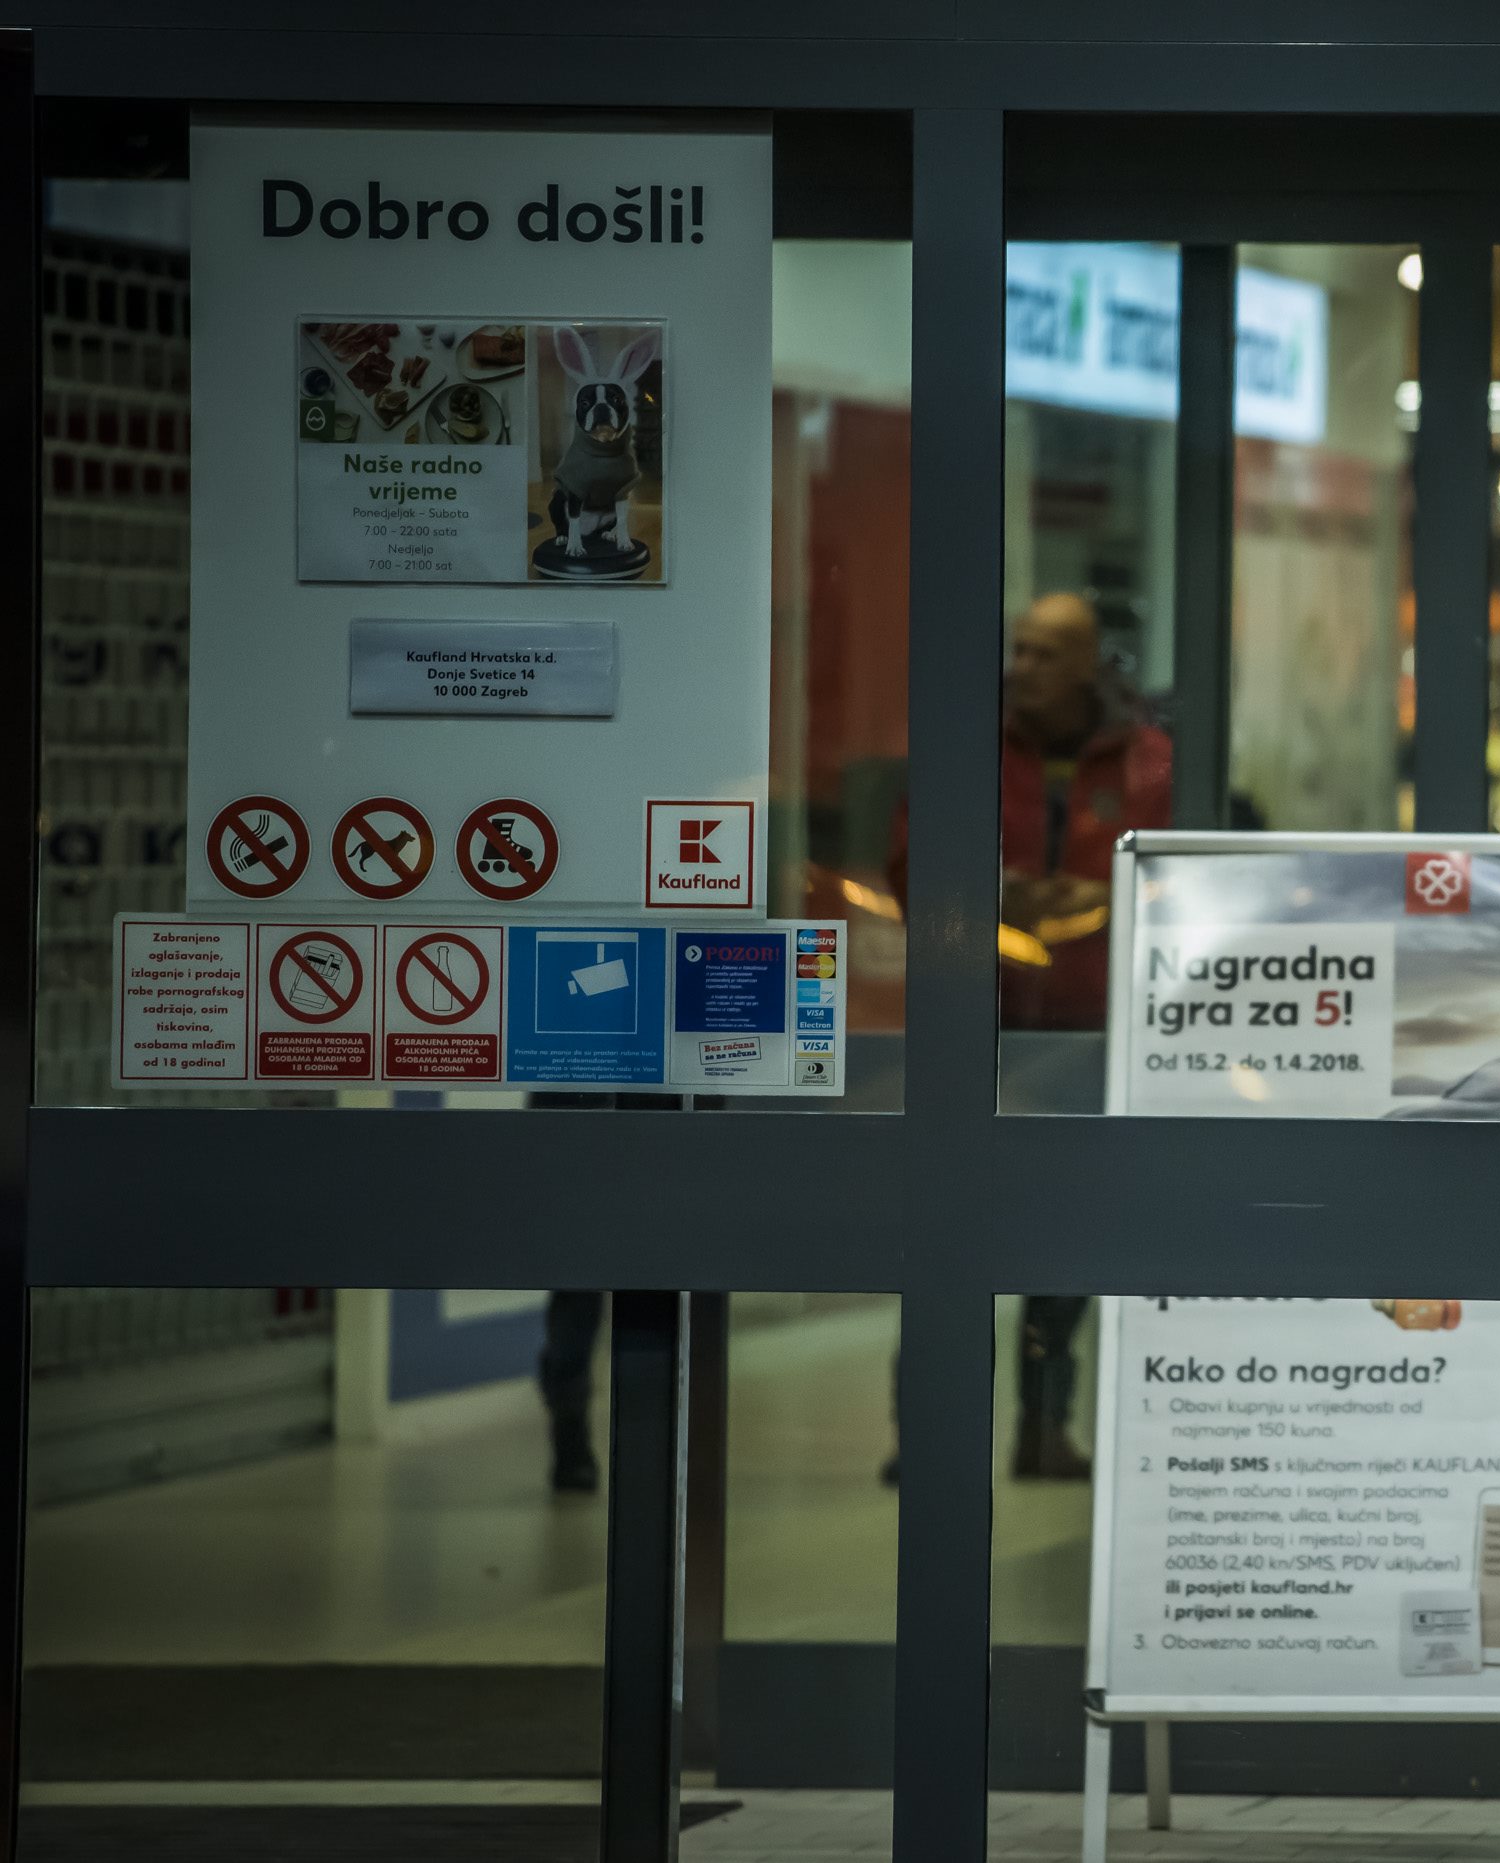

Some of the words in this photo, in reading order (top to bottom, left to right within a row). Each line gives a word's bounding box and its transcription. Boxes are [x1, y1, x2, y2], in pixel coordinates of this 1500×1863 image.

[262, 179, 490, 241] Dobro
[517, 184, 704, 245] došli!
[344, 453, 403, 474] Naše
[411, 455, 483, 474] radno
[369, 481, 457, 505] vrijeme
[353, 507, 416, 520] Ponedjeljak
[429, 508, 469, 519] Subota
[433, 526, 457, 537] sata
[388, 544, 434, 556] Nedjelja
[435, 561, 453, 571] sat
[407, 651, 466, 663] Kaufland
[471, 652, 530, 663] Hrvatska
[535, 652, 557, 663] k.d.
[427, 668, 465, 682] Donje
[470, 668, 516, 680] Svetice
[521, 669, 535, 680] 14
[434, 685, 447, 696] 10
[452, 685, 477, 697] 000
[481, 686, 528, 700] Zagreb
[659, 873, 740, 889] Kaufland
[153, 933, 220, 944] Zabranjeno
[798, 937, 836, 946] Maestro
[149, 951, 223, 962] oglašavanje,
[706, 946, 780, 961] POZOR!
[131, 968, 184, 980] izlaganje
[188, 968, 191, 977] i
[195, 969, 240, 980] prodaja
[1149, 944, 1375, 990] Nagradna
[127, 986, 153, 995] robe
[158, 987, 244, 999] pornografskog
[143, 1004, 196, 1016] sadržaja,
[201, 1005, 228, 1014] osim
[1146, 991, 1233, 1037] igra
[1248, 1002, 1299, 1026] za
[1315, 989, 1353, 1027] 5!
[157, 1022, 213, 1033] tiskovina,
[134, 1040, 188, 1049] osobama
[192, 1040, 235, 1050] mlađim
[267, 1037, 322, 1045] ZABRANJENA
[394, 1038, 449, 1046] ZABRANJENA
[803, 1042, 829, 1051] VISA
[316, 1046, 365, 1054] PROIZVODA
[143, 1057, 158, 1067] od
[164, 1058, 176, 1067] 18
[181, 1058, 225, 1069] godina!
[1144, 1053, 1178, 1072] Od
[1185, 1053, 1232, 1072] 15.2.
[1239, 1053, 1267, 1072] do
[1274, 1053, 1365, 1072] 1.4.2018.
[1144, 1356, 1226, 1384] Kako
[1236, 1356, 1279, 1384] do
[1288, 1356, 1447, 1391] nagrada?
[1168, 1397, 1222, 1414] Obavi
[1226, 1398, 1284, 1417] kupnju
[1289, 1402, 1300, 1414] u
[1306, 1398, 1394, 1416] vrijednosti
[1399, 1398, 1423, 1414] od
[1171, 1423, 1251, 1440] najmanje
[1256, 1423, 1285, 1438] 150
[1290, 1423, 1336, 1438] kuna.
[1167, 1456, 1225, 1476] Pošalji
[1230, 1457, 1269, 1474] SMS
[1273, 1461, 1282, 1473] s
[1287, 1457, 1362, 1476] ključnom
[1368, 1457, 1408, 1476] riječi
[1168, 1484, 1228, 1501] brojem
[1233, 1483, 1292, 1499] računa
[1306, 1484, 1358, 1501] svojim
[1363, 1485, 1449, 1502] podacima
[1167, 1506, 1208, 1524] (ime,
[1213, 1508, 1284, 1525] prezime,
[1289, 1507, 1331, 1524] ulica,
[1337, 1507, 1381, 1523] kućni
[1386, 1508, 1422, 1526] broj,
[1166, 1532, 1248, 1549] poštanski
[1252, 1532, 1285, 1549] broj
[1299, 1532, 1361, 1549] mjesto)
[1367, 1536, 1388, 1547] na
[1393, 1533, 1425, 1550] broj
[1165, 1555, 1218, 1571] 60036
[1342, 1555, 1381, 1570] PDV
[1165, 1579, 1180, 1594] ili
[1185, 1580, 1246, 1597] posjeti
[1251, 1579, 1354, 1595] kaufland.hr
[1164, 1604, 1169, 1618] i
[1174, 1604, 1231, 1622] prijavi
[1236, 1607, 1254, 1618] se
[1260, 1604, 1320, 1619] online.
[1160, 1633, 1251, 1650] Obavezno
[1256, 1635, 1321, 1653] sačuvaj
[1326, 1636, 1379, 1650] račun.
